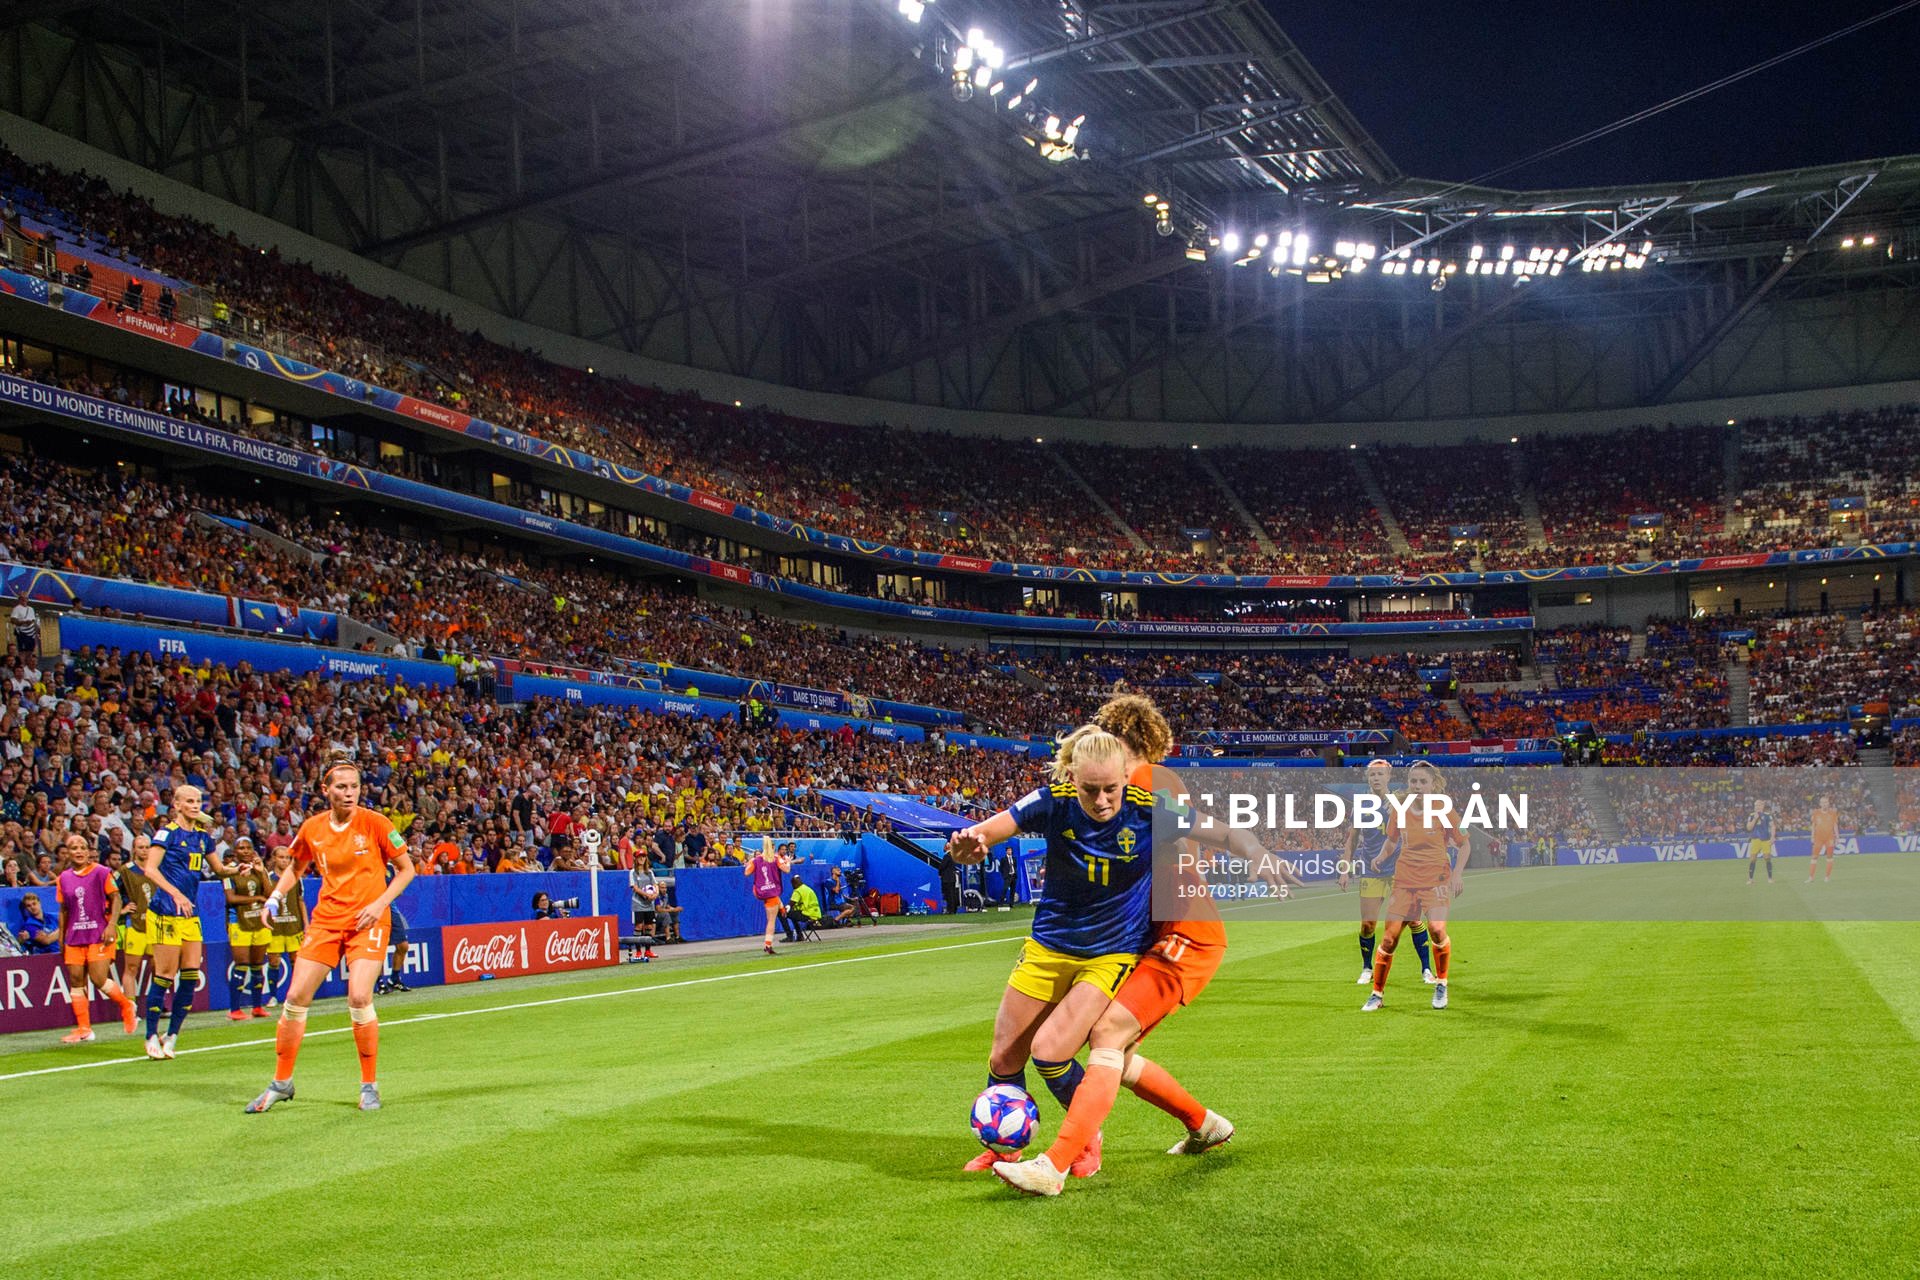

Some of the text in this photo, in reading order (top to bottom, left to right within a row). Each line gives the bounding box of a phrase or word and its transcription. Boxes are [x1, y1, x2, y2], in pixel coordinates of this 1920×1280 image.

[126, 315, 169, 336] #FIFAWWC
[0, 379, 29, 401] UPE
[32, 387, 52, 405] DU
[56, 393, 105, 419] MONDE
[108, 406, 167, 435] FÉMININE
[170, 423, 186, 439] DE
[188, 427, 203, 443] LA
[233, 439, 274, 461] FRANCE
[276, 451, 299, 467] 2019
[723, 567, 738, 580] LYON
[1139, 624, 1154, 633] FIFA
[1155, 624, 1190, 633] WOMEN'S
[1190, 625, 1216, 633] WORLD
[1216, 625, 1231, 633] CUP
[1261, 626, 1277, 634] 2019
[159, 638, 187, 654] FIFA
[328, 658, 380, 675] #FIFAWWC
[566, 687, 583, 700] FIFA
[793, 690, 837, 707] DARE TO SHINE
[1241, 733, 1329, 742] LE MOMENT DE BRILLER
[188, 852, 202, 871] 10
[1573, 847, 1619, 865] VISA
[1650, 844, 1698, 861] VISA
[1083, 854, 1110, 887] 11
[368, 927, 383, 948] 4
[545, 927, 601, 965] Coca-Cola
[453, 934, 517, 974] Coca-Cola
[0, 968, 34, 1011] R
